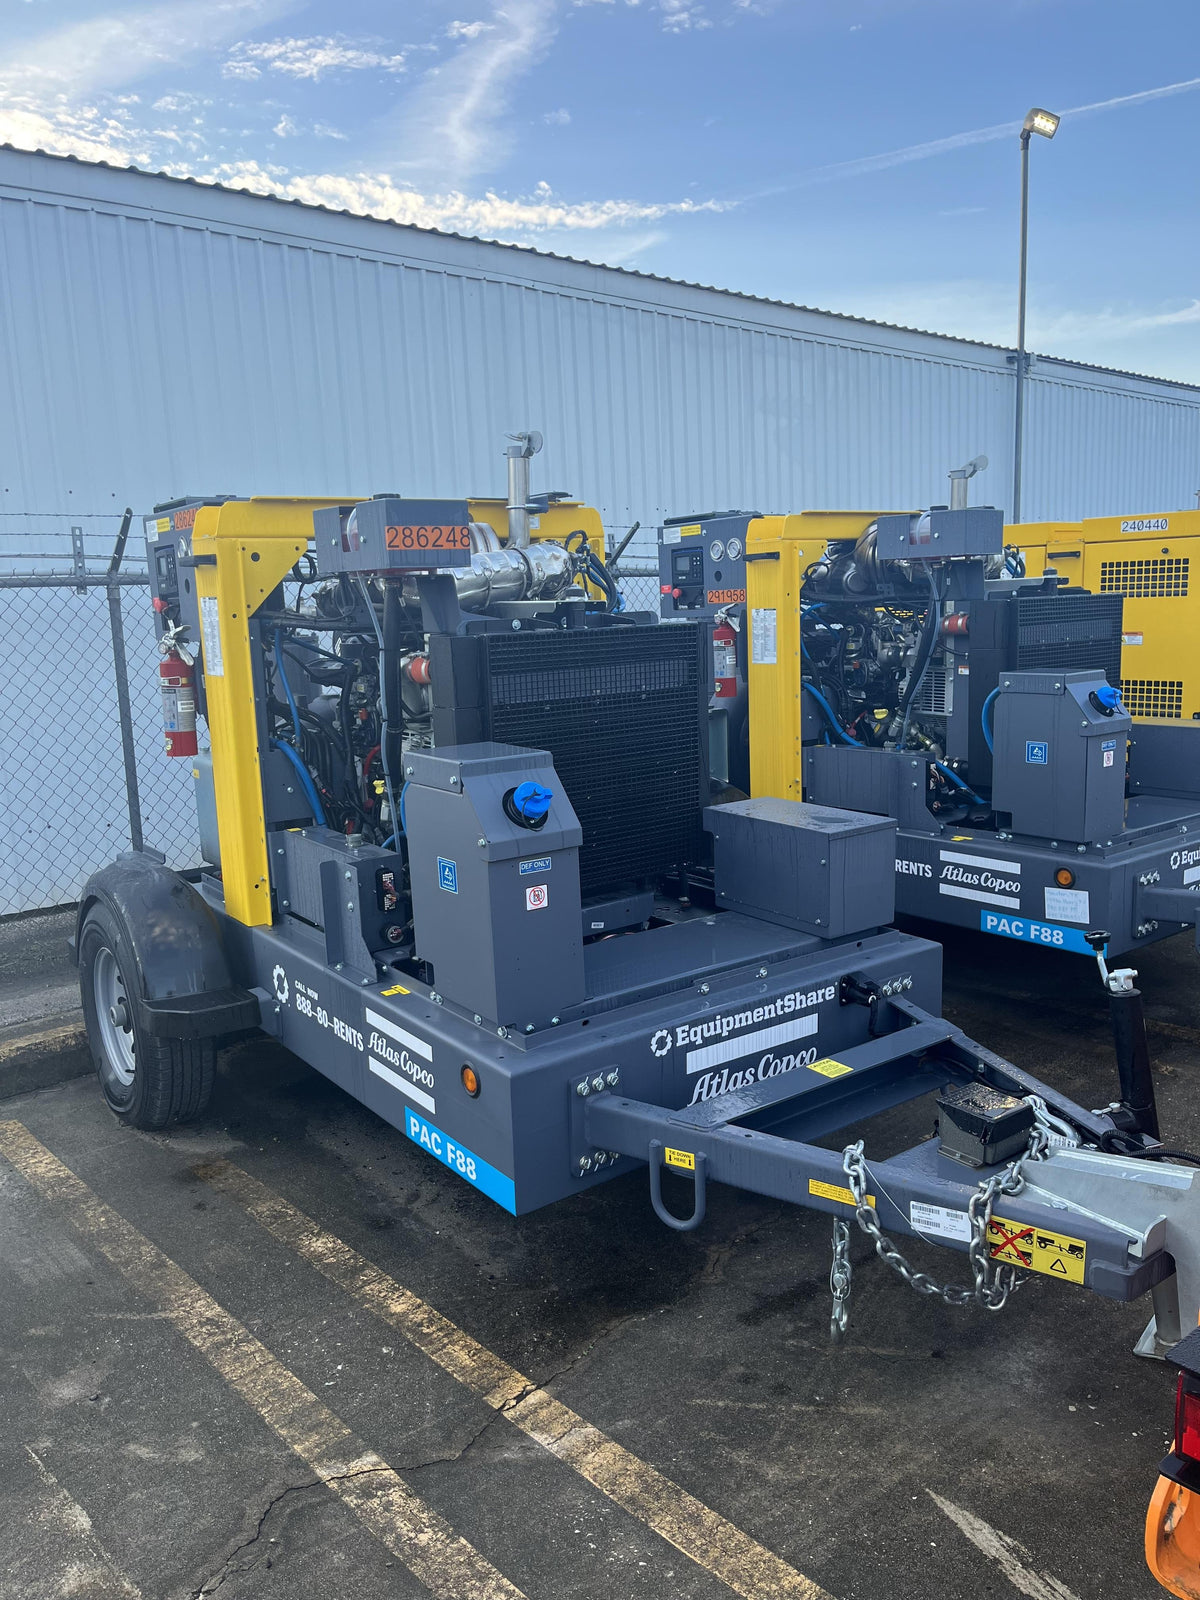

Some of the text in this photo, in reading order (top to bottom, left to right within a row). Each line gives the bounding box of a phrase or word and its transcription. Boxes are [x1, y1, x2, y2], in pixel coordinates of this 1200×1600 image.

[174, 508, 199, 530] 28624
[1121, 518, 1168, 532] 240440
[386, 526, 471, 549] 286248
[708, 589, 746, 603] 291958
[521, 860, 550, 870] DEF ONLY
[939, 865, 1022, 893] Atlas Copco
[986, 915, 1064, 945] PAC F88
[294, 979, 307, 994] CALL
[295, 992, 364, 1052] 888-80-RENTS
[675, 983, 836, 1046] EquipmentShare
[368, 1031, 435, 1089] Atlas Copco
[686, 1067, 755, 1108] Atlas
[409, 1115, 477, 1181] PAC F88
[676, 1151, 692, 1159] DOWN
[673, 1156, 687, 1164] HERE
